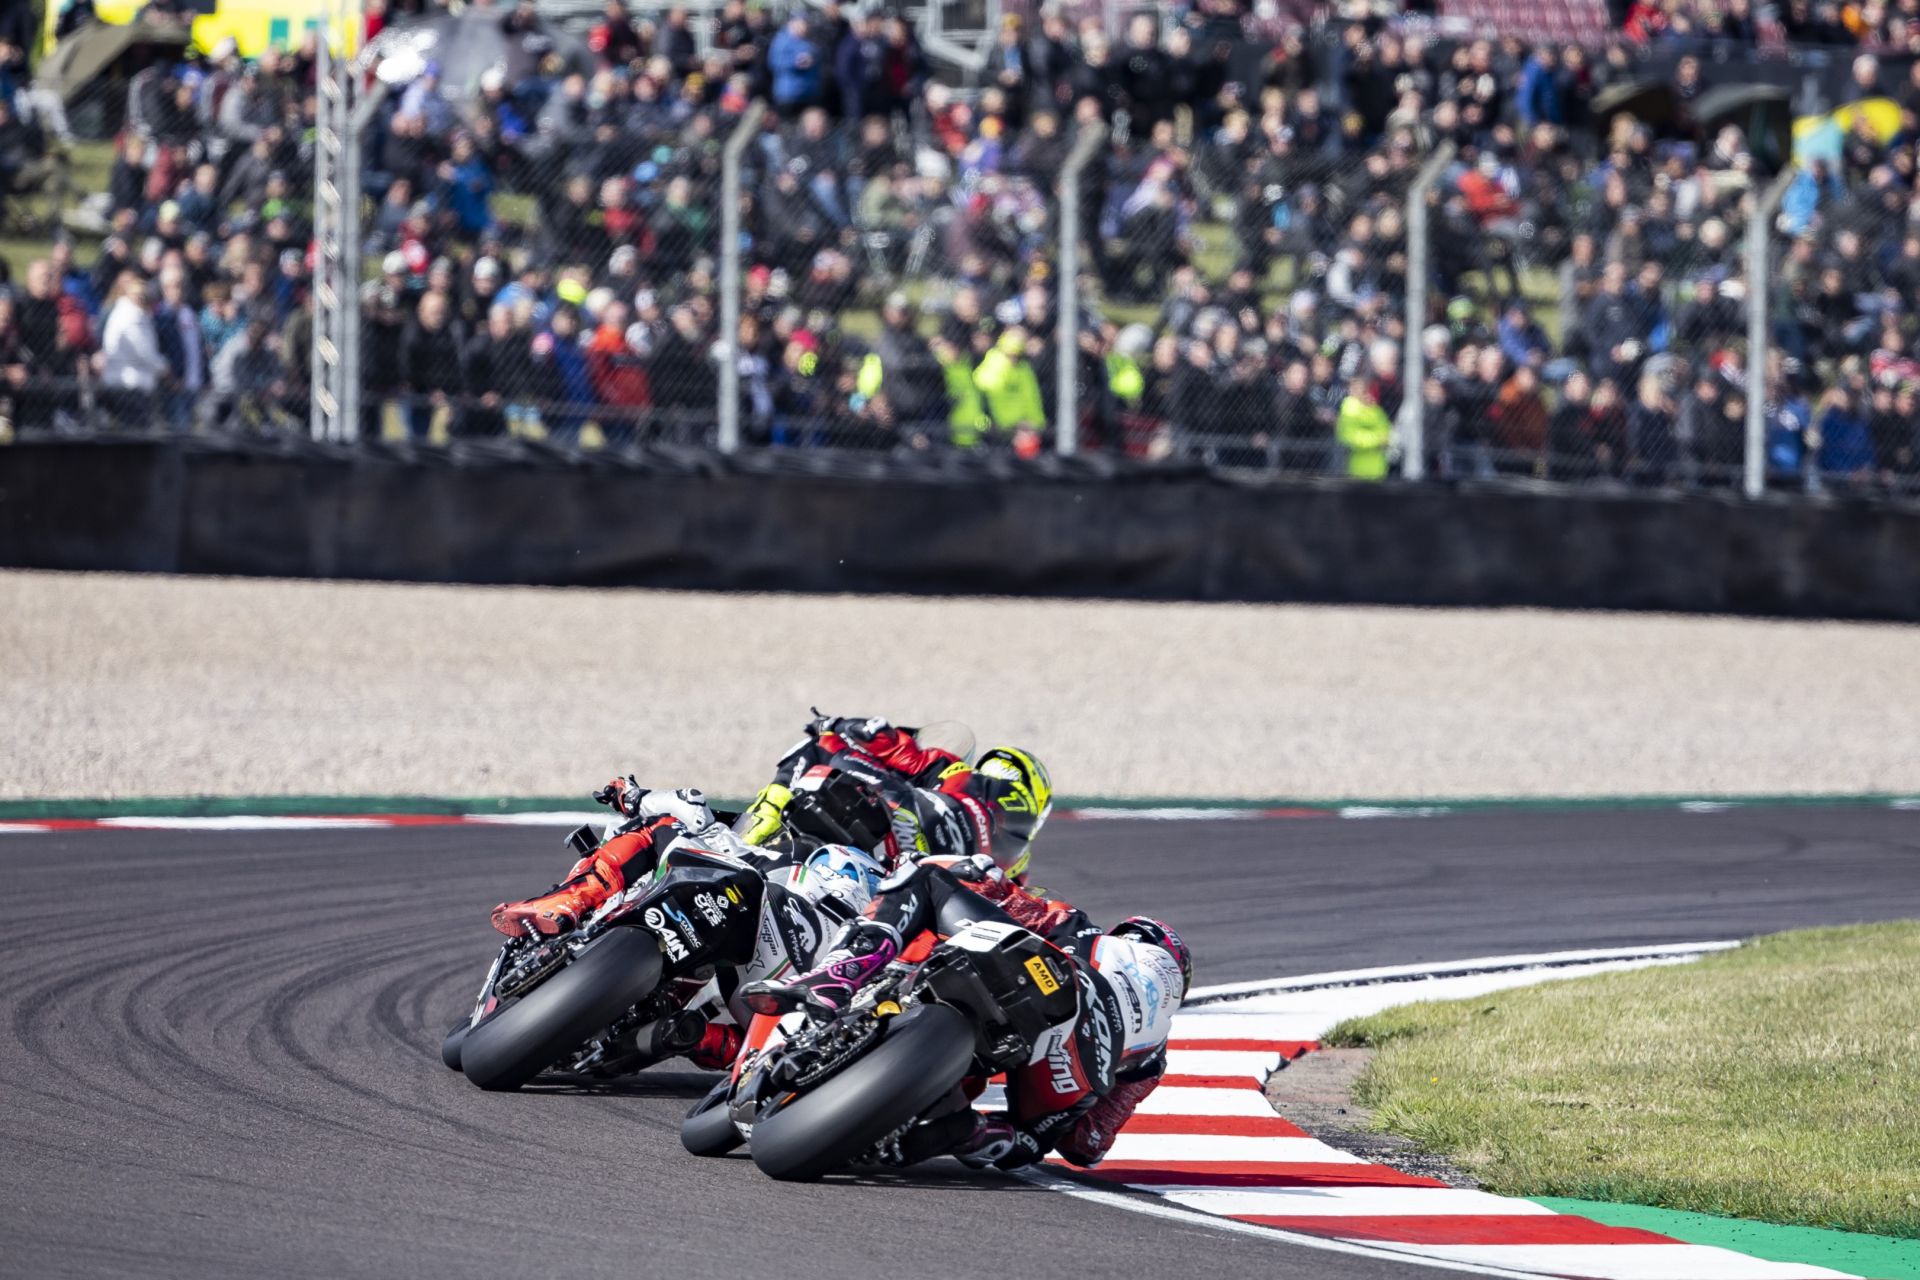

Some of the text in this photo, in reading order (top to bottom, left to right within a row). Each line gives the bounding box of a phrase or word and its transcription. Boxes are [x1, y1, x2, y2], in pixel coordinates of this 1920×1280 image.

[960, 797, 988, 847] DUCATI
[659, 928, 690, 961] AJN
[680, 919, 702, 948] SAFEPAC
[1033, 961, 1054, 989] AMD
